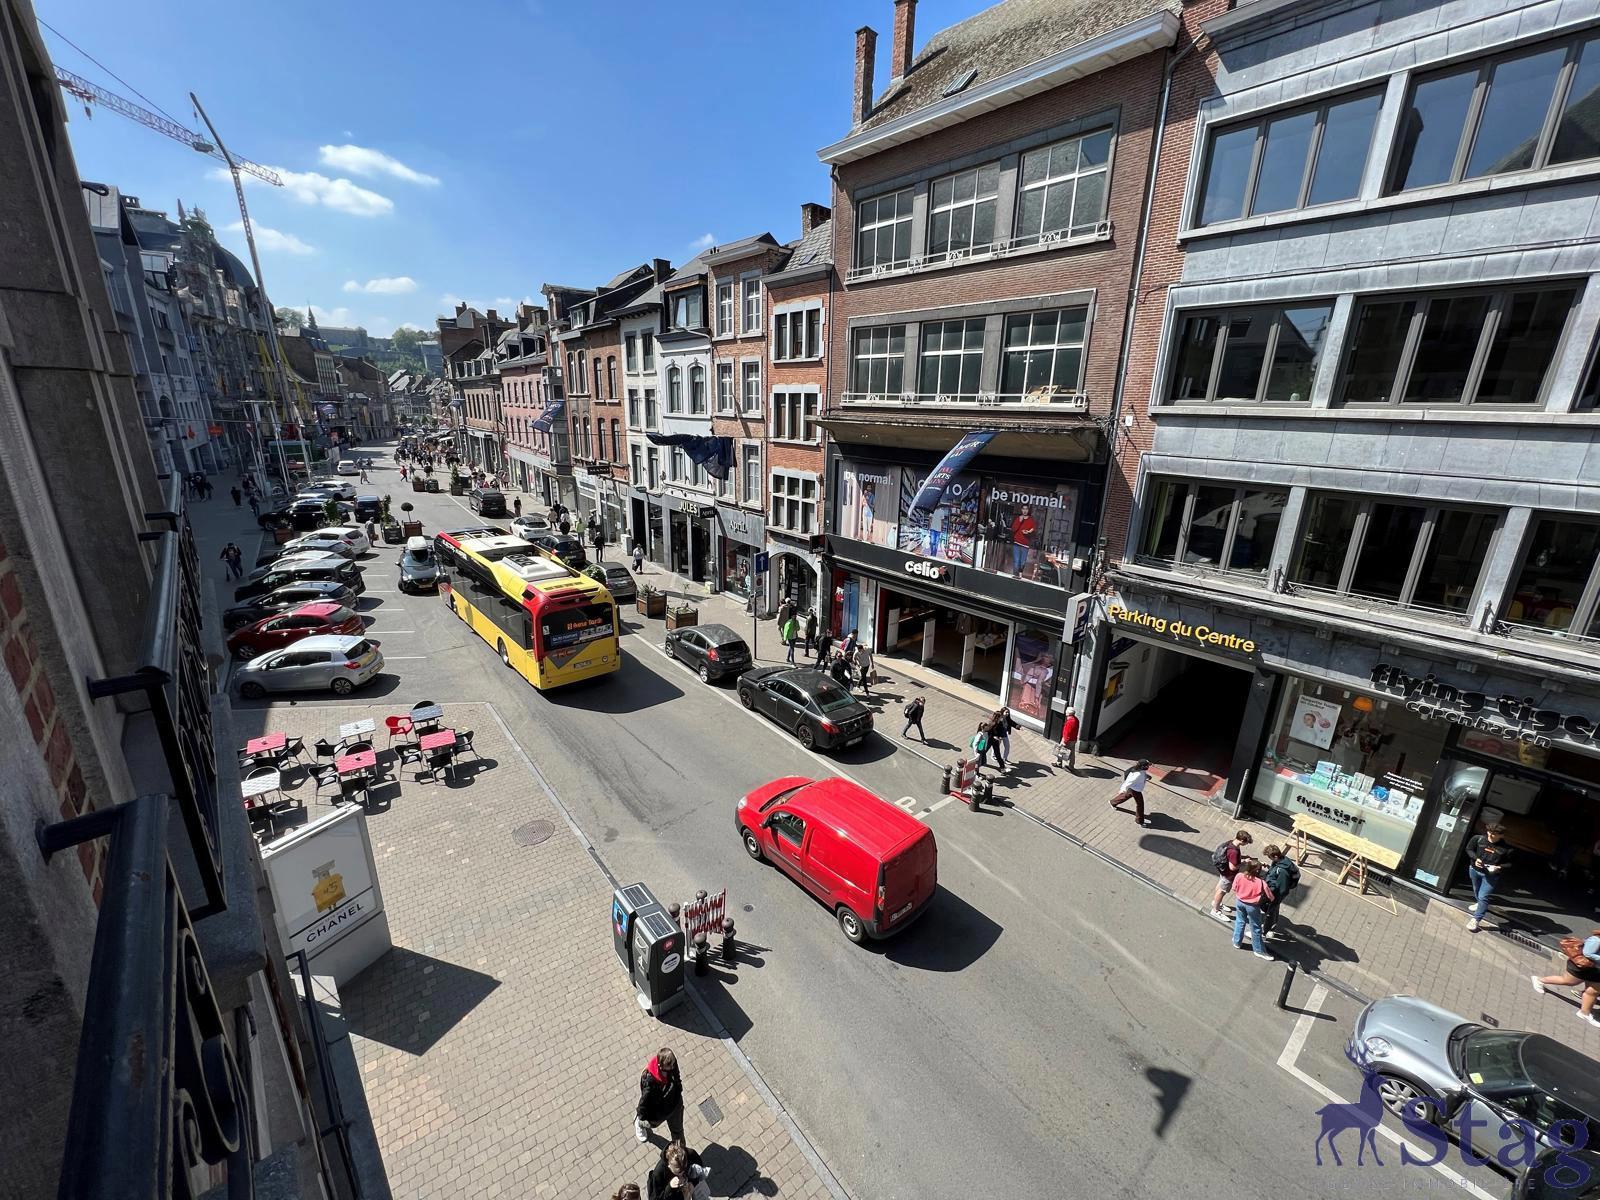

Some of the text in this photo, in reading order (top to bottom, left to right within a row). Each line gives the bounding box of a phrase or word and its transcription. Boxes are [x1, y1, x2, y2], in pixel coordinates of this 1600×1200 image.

[678, 500, 698, 514] JULES
[991, 487, 1067, 509] be normal.
[905, 560, 939, 579] celio
[1109, 604, 1255, 652] Parking du Centre
[1371, 663, 1486, 713] flying
[1405, 700, 1551, 749] copenhagen
[1296, 795, 1366, 825] flying tiger
[1307, 808, 1349, 826] copenhagen
[306, 903, 364, 943] CHANEL
